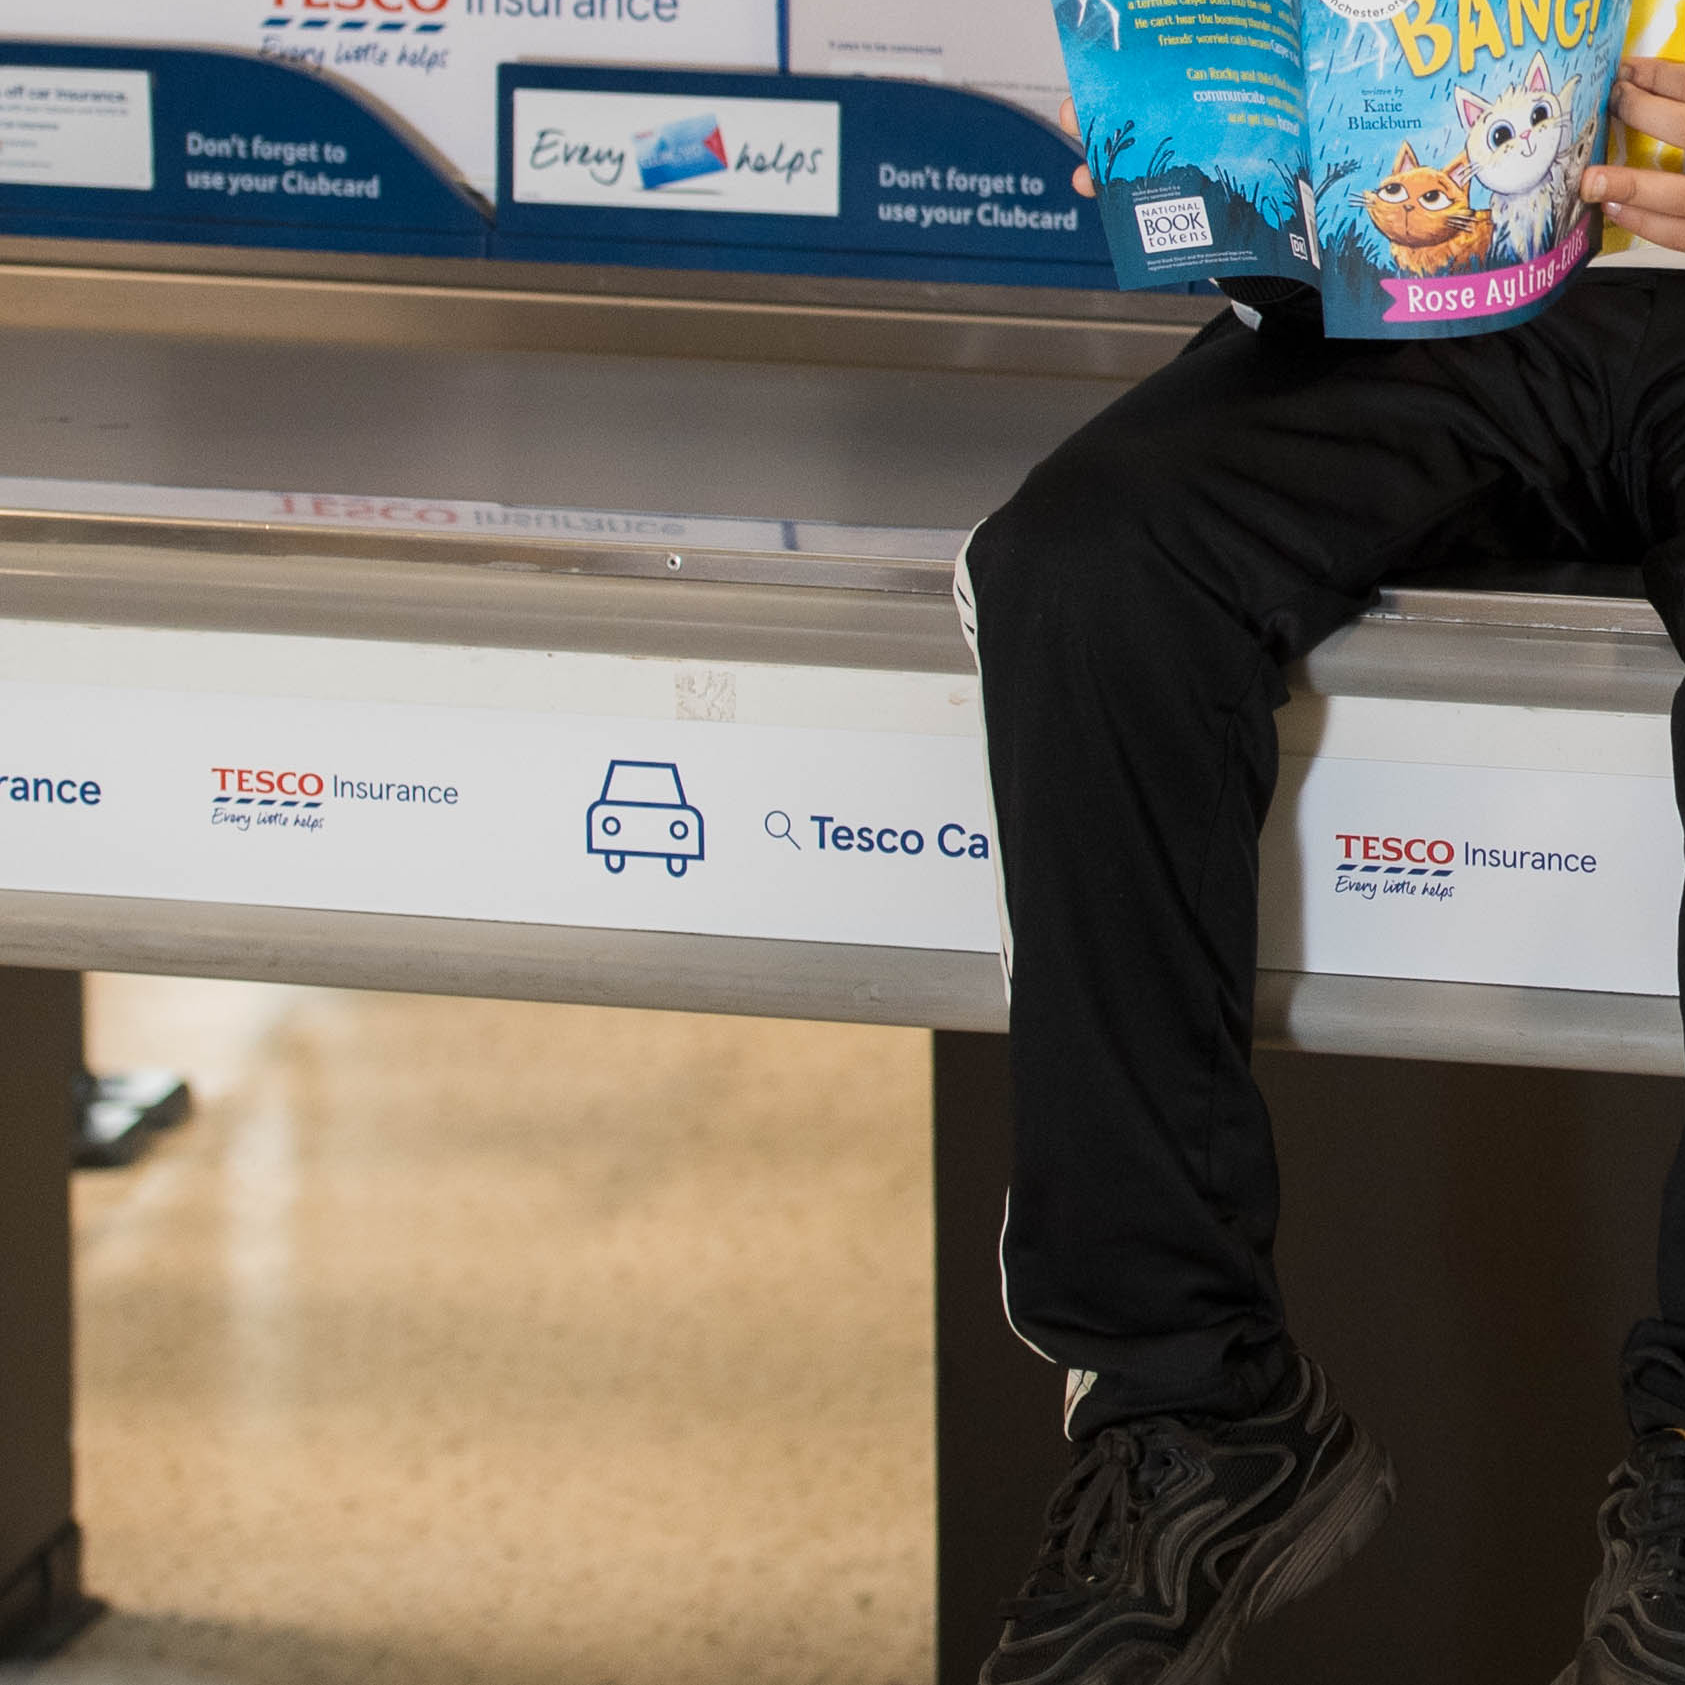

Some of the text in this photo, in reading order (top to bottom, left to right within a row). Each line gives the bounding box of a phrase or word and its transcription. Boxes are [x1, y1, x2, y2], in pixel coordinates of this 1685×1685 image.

[259, 36, 450, 74] Every little helps
[1193, 89, 1266, 105] communicate
[1364, 98, 1403, 112] Katie
[1348, 116, 1422, 131] Blackburn
[185, 131, 348, 166] Don't forget to
[529, 127, 823, 187] Every helps
[185, 169, 381, 199] use your Clubcard
[878, 162, 1045, 201] Don't forget to
[877, 201, 1079, 233] use your Clubcard
[1141, 203, 1201, 217] NATIONAL
[1144, 211, 1205, 237] BOOK
[1150, 229, 1208, 248] tokens
[1407, 229, 1586, 313] Rose Ayling-Ellis
[211, 767, 460, 806] TESCO Insurance
[211, 807, 325, 833] Every little helps
[809, 814, 926, 856] Tesco
[1335, 833, 1597, 874] TESCO Insurance
[1334, 874, 1455, 902] Every little helps
